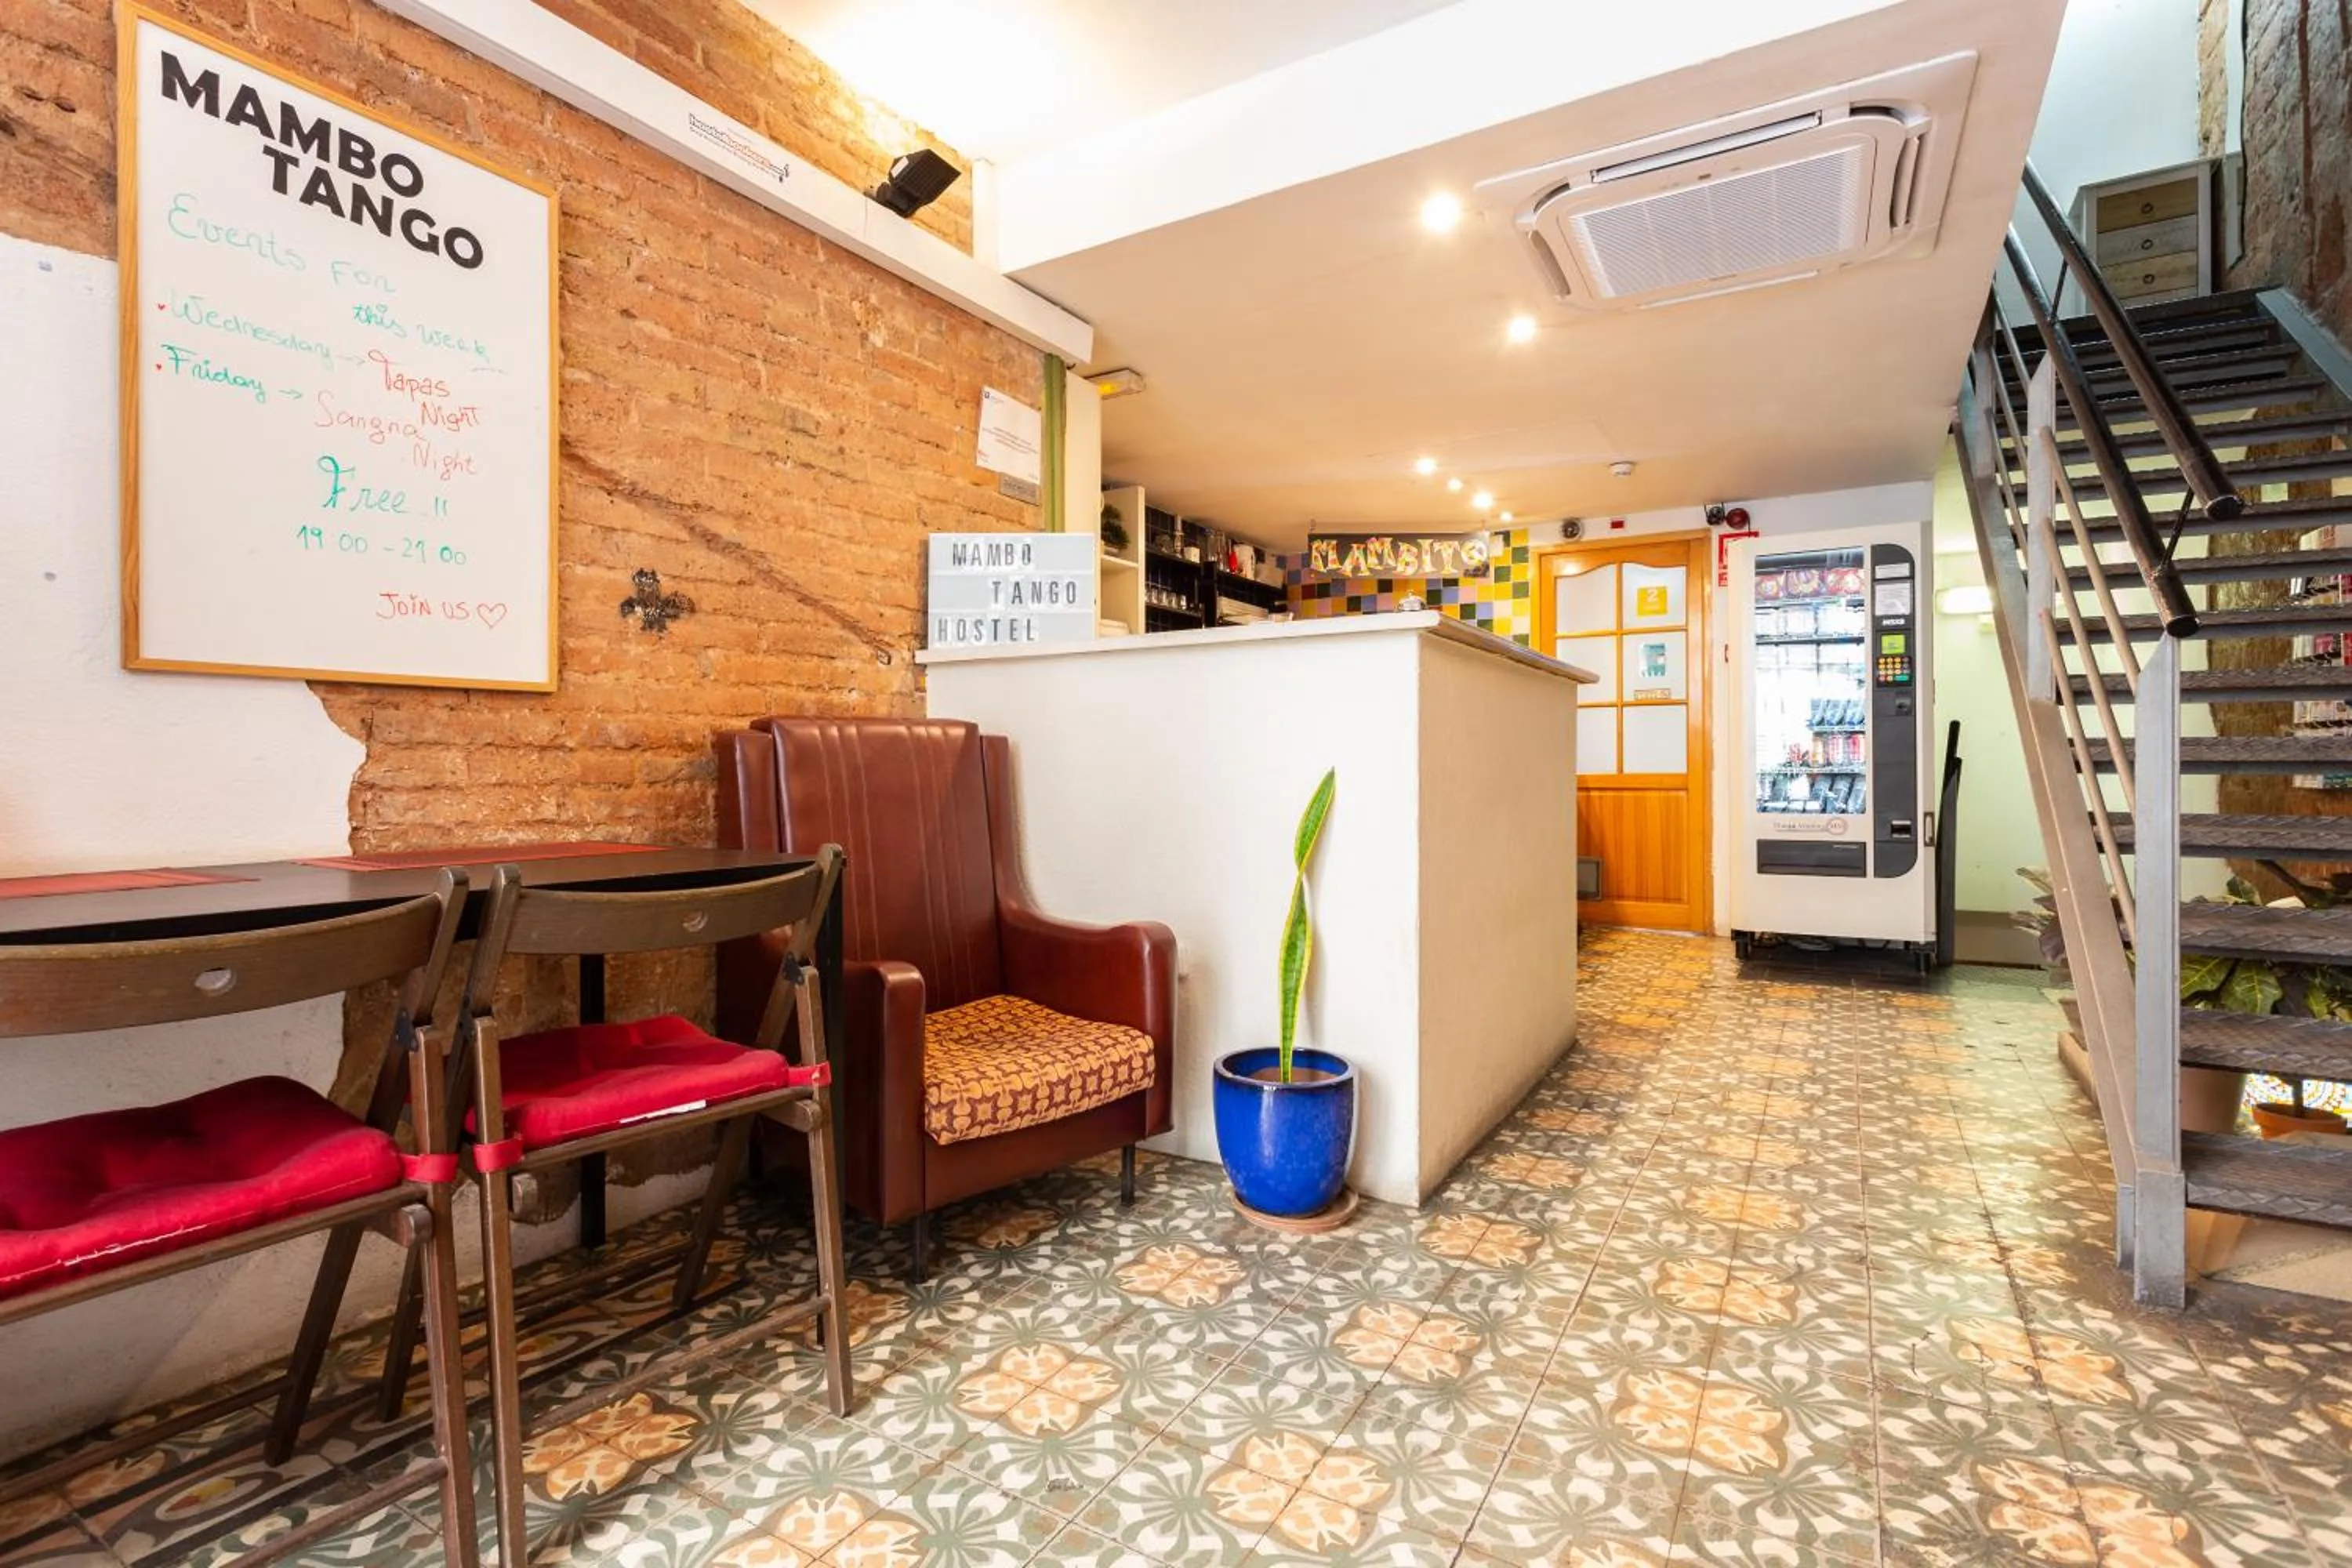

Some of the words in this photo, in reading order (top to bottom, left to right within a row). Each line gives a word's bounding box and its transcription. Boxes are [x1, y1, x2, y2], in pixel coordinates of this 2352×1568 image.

[160, 49, 424, 198] MAMBO
[262, 143, 484, 270] TANGO
[168, 192, 307, 272] Events
[352, 302, 408, 338] this
[171, 287, 335, 371] Wednesday
[367, 349, 451, 401] Tapas
[160, 343, 267, 404] Friday
[419, 401, 481, 433] Night
[412, 441, 477, 481] Night
[316, 454, 409, 514] Free
[952, 543, 1032, 567] MAMBO
[1308, 535, 1488, 577] MAMBITO
[992, 580, 1077, 604] TANGO
[937, 618, 1036, 642] HOSTEL
